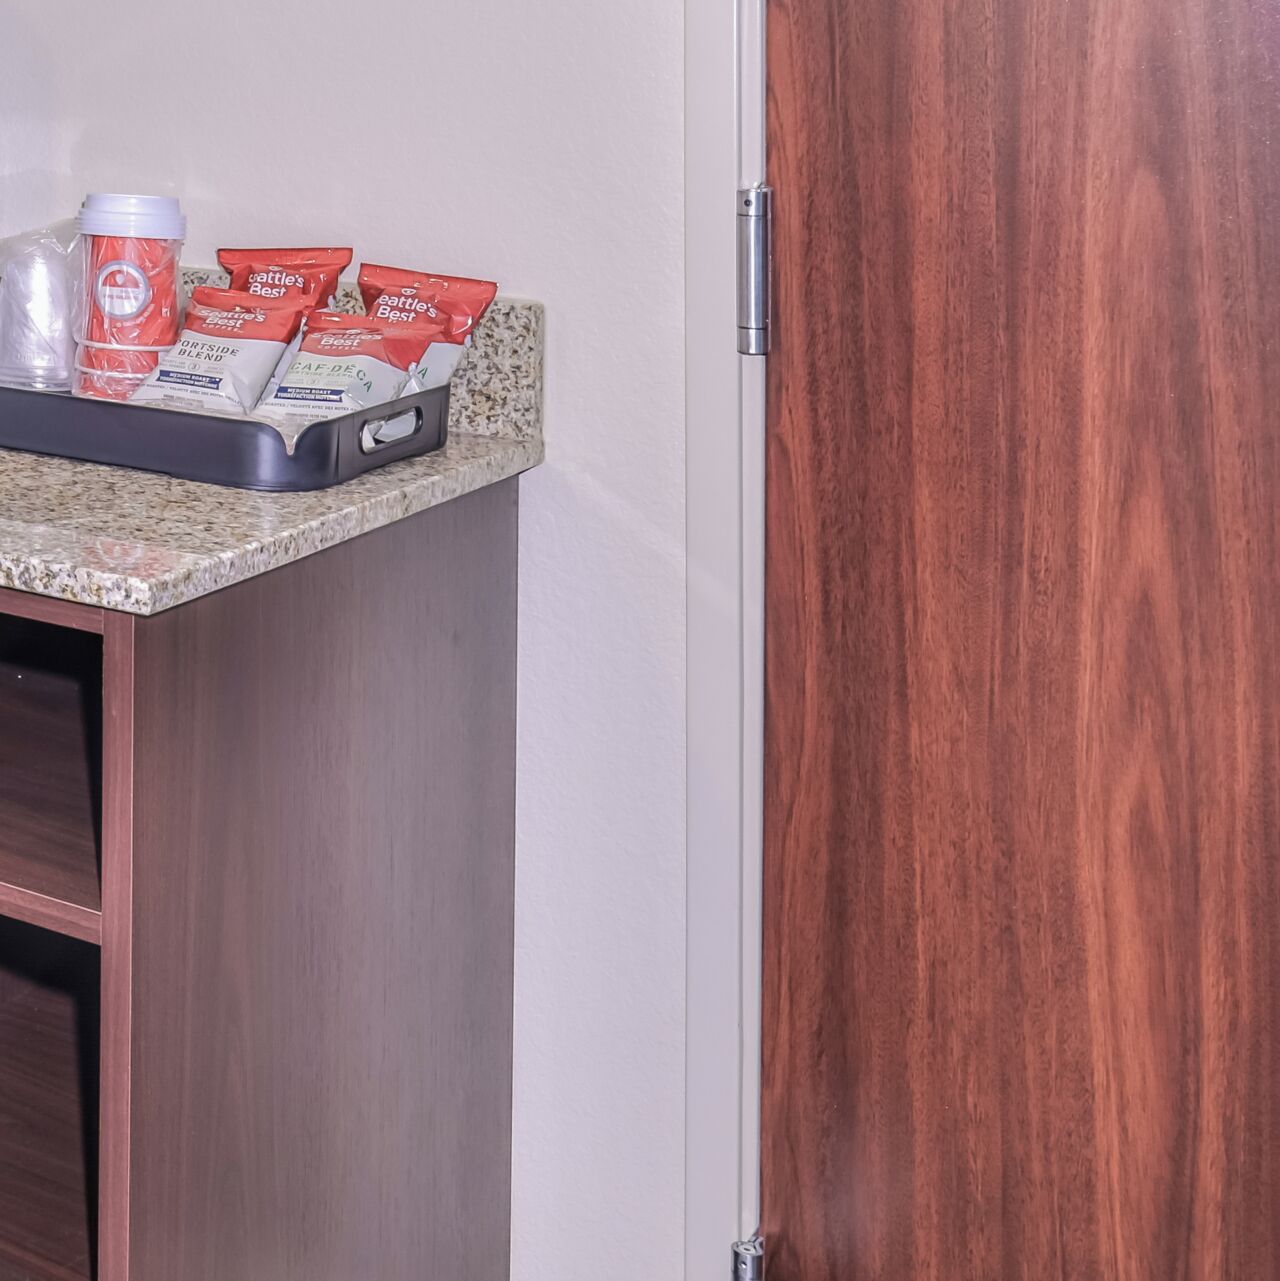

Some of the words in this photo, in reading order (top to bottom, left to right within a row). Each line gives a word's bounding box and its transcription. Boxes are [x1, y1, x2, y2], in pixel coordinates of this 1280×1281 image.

[249, 282, 287, 298] Best
[374, 294, 438, 318] eattle's
[376, 305, 417, 322] Best
[205, 316, 244, 328] Best
[180, 339, 240, 357] ORTSIDE
[320, 337, 361, 346] Best
[178, 348, 223, 362] BLEND
